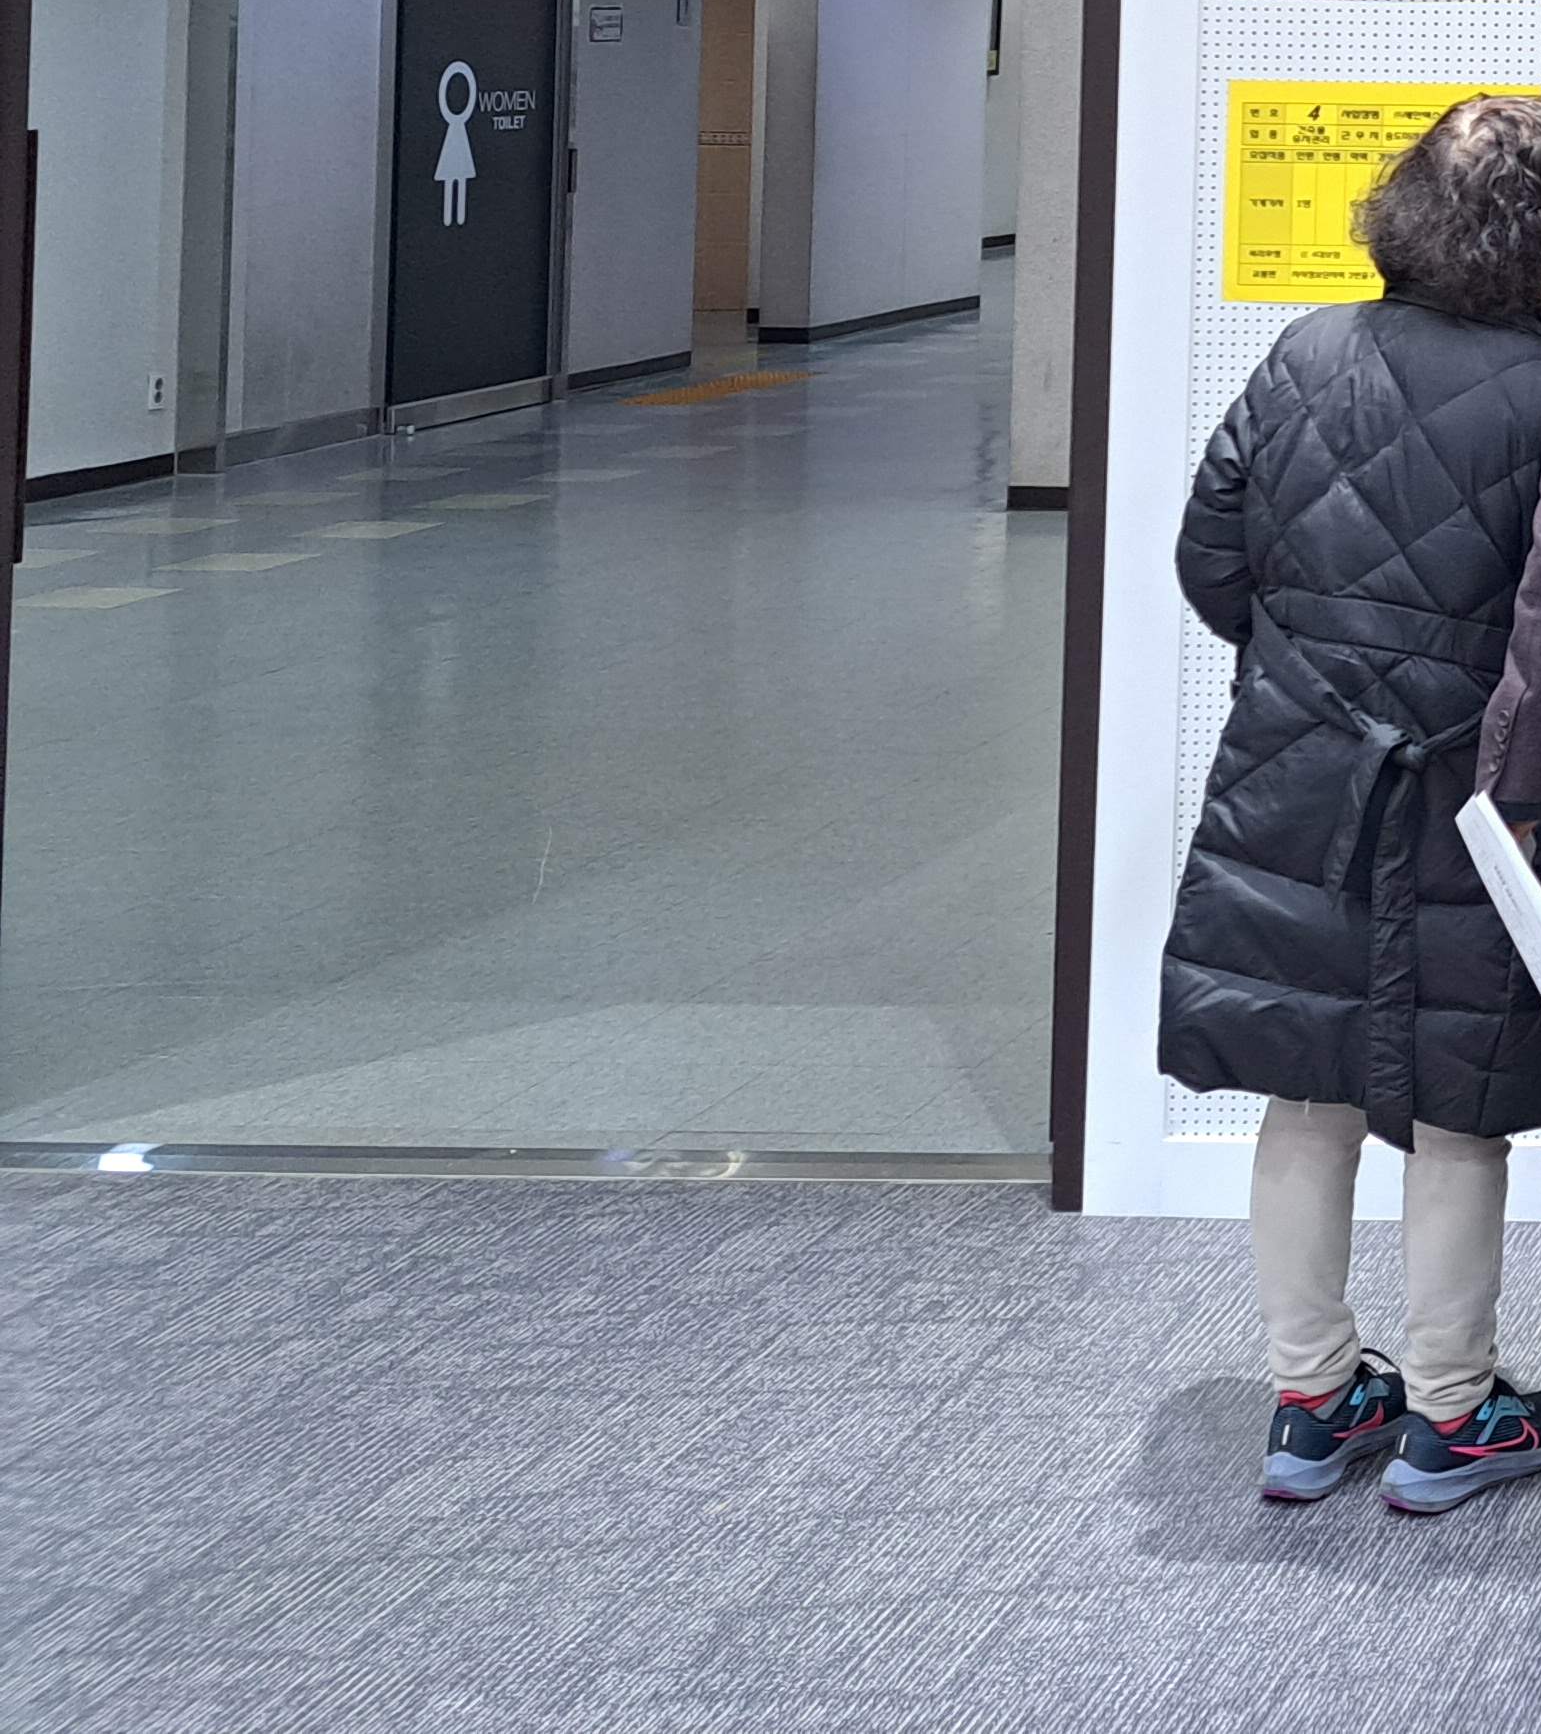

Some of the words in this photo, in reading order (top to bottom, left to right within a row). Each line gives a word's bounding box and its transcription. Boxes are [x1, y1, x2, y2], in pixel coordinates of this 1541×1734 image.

[478, 90, 536, 113] WOMEN
[1306, 105, 1321, 121] 4
[492, 114, 527, 130] TOILET
